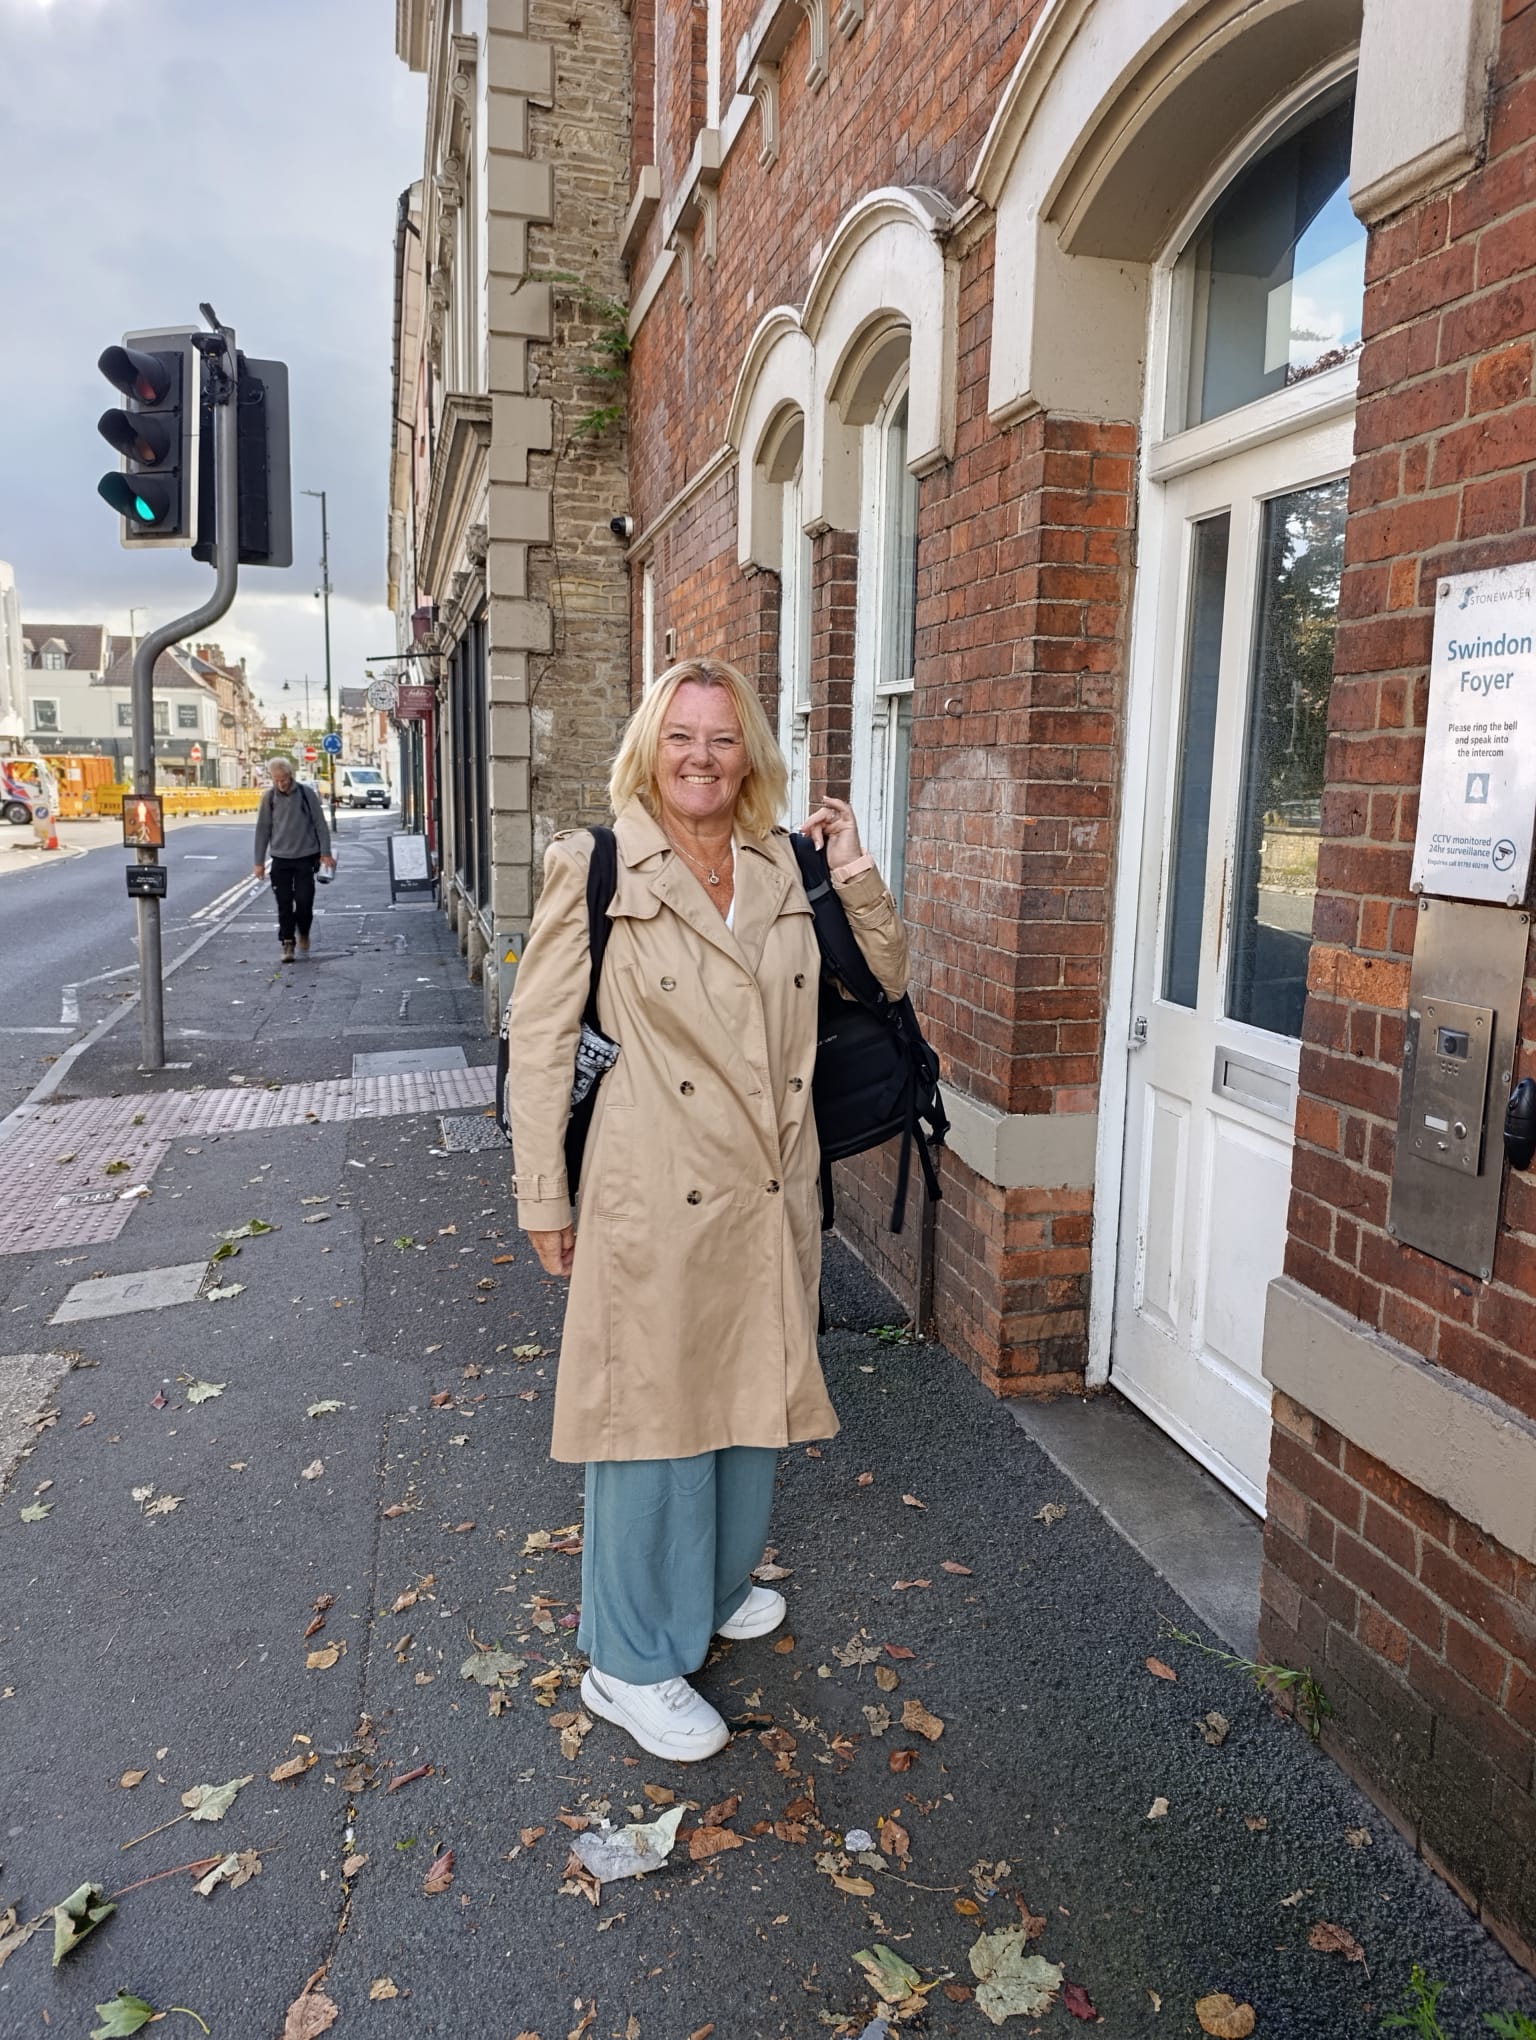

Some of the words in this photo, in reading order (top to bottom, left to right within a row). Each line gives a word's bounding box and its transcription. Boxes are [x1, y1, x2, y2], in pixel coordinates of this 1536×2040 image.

[1470, 588, 1530, 605] STONEWATER
[1448, 633, 1532, 661] Swindon
[1461, 671, 1514, 696] Foyer
[1448, 723, 1471, 732] Please
[1473, 722, 1488, 733] ring
[1490, 721, 1502, 730] the
[1504, 720, 1518, 730] bell
[1455, 735, 1469, 744] and
[1471, 735, 1492, 746] speak
[1493, 735, 1509, 743] into
[1458, 748, 1470, 757] the
[1471, 748, 1504, 757] intercom
[1432, 834, 1451, 843] CCTV
[1452, 836, 1492, 846] monitored
[1428, 844, 1445, 853] 24hr
[1446, 847, 1490, 857] surveillance
